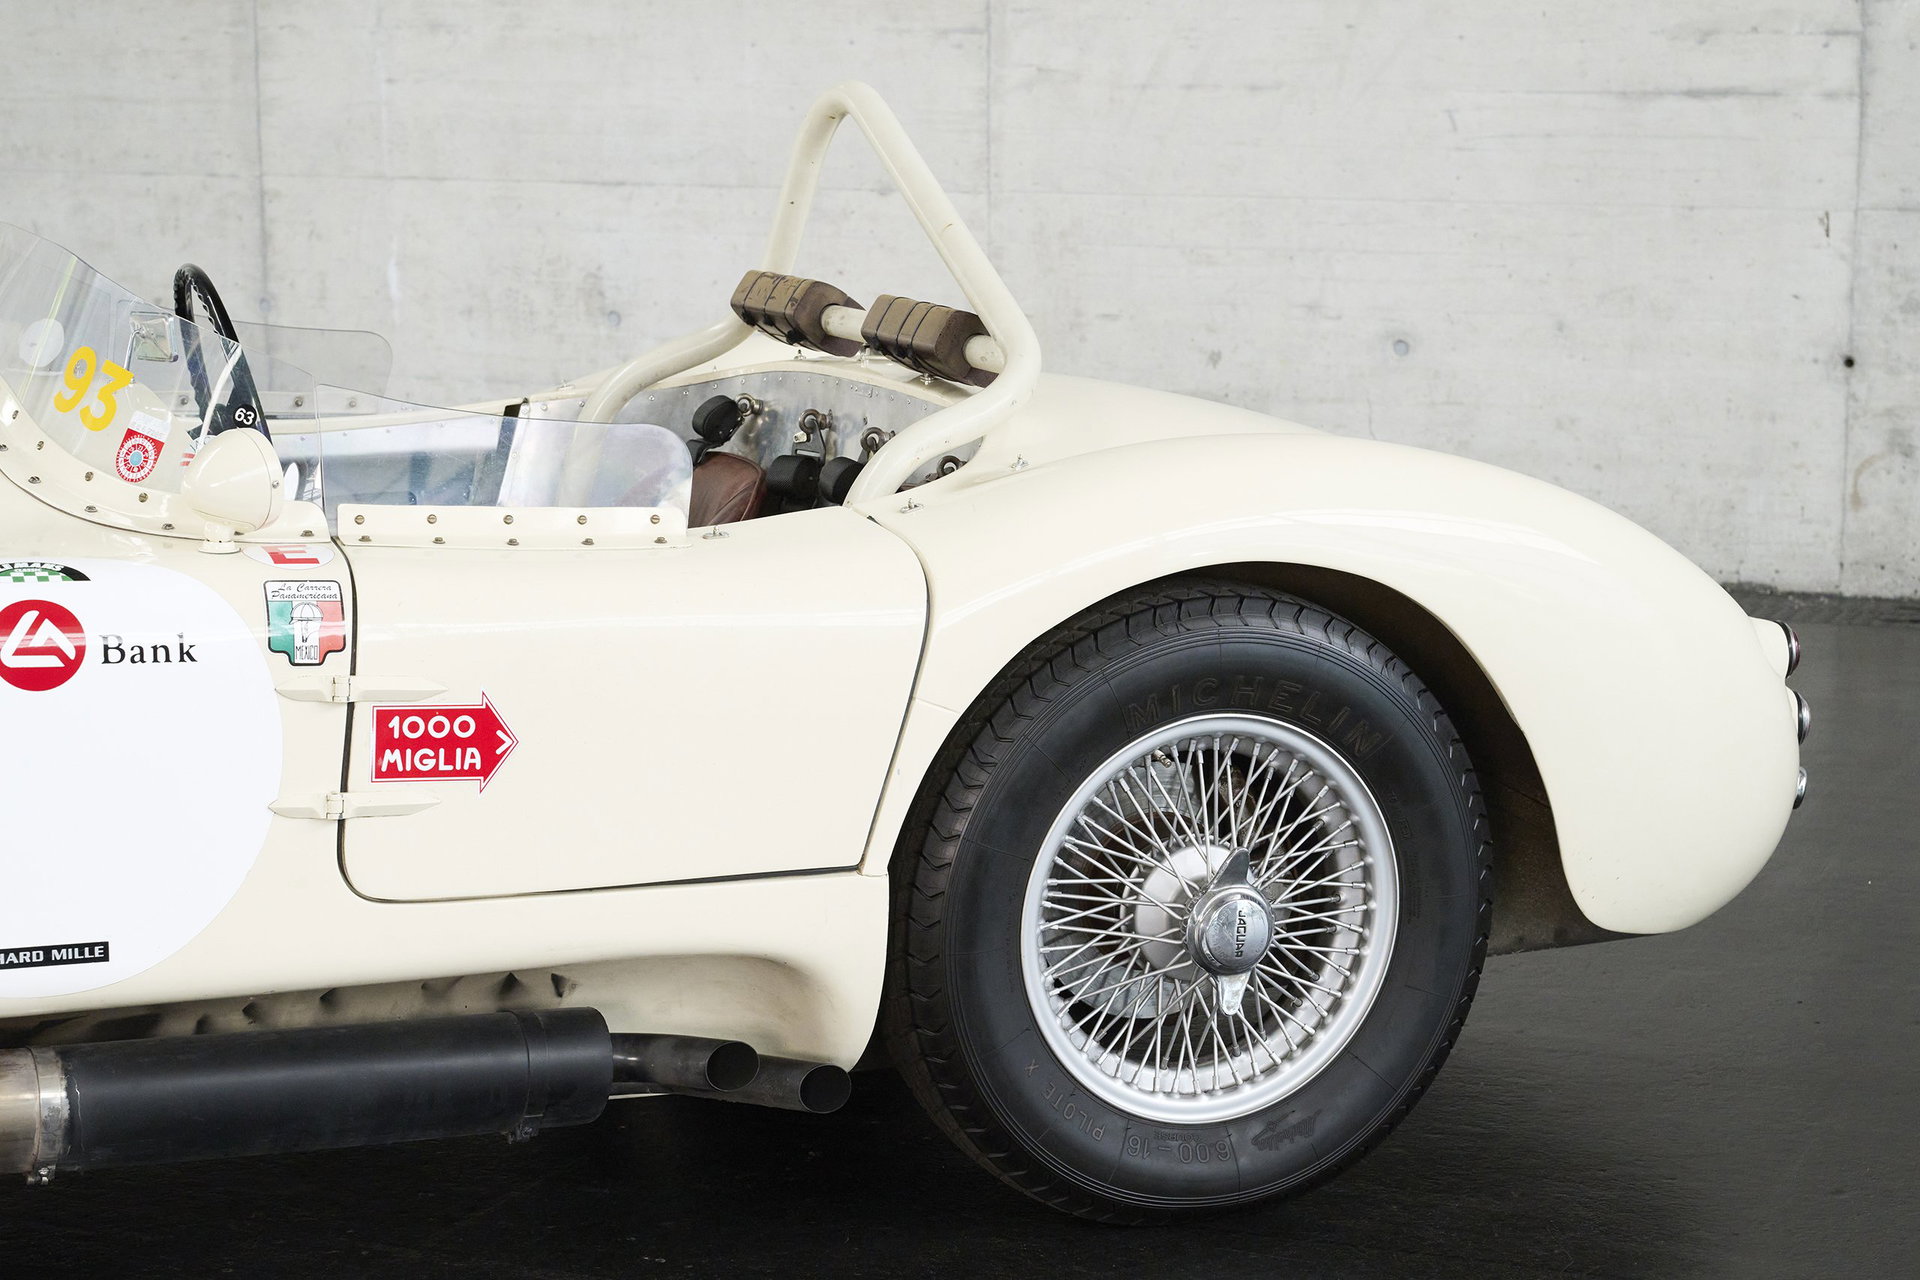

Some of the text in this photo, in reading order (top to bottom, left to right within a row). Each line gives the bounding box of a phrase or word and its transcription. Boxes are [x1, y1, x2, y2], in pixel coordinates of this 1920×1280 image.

[54, 346, 134, 432] 93
[234, 407, 255, 425] 63
[271, 590, 338, 600] Panamericana
[277, 583, 332, 593] La Carrera
[99, 631, 199, 665] Bank
[295, 645, 319, 661] MEXICO
[388, 714, 477, 740] 1000
[1127, 674, 1383, 757] MICHELIN
[381, 746, 482, 773] MIGLIA
[1234, 909, 1248, 958] JAGUAR
[51, 945, 105, 961] MILLE
[1041, 1081, 1106, 1141] PILOTE
